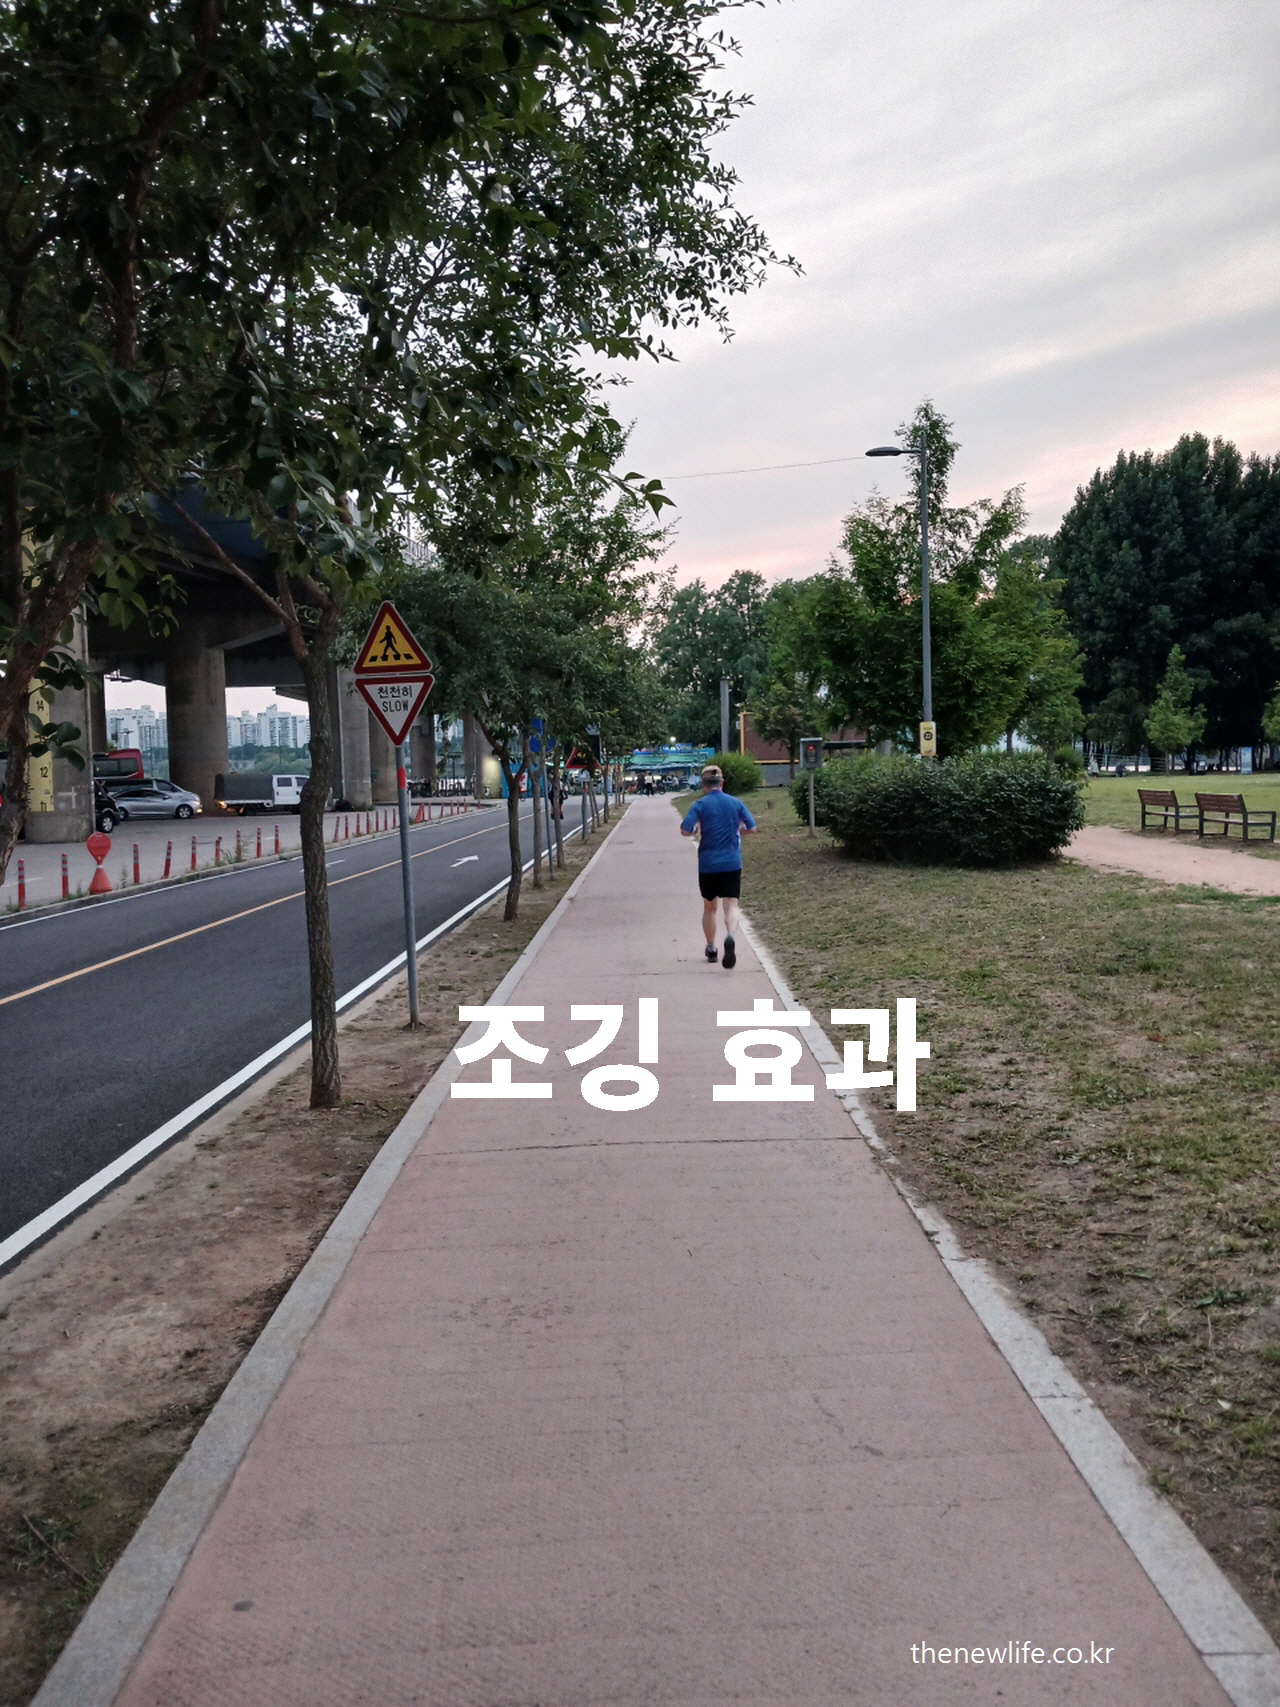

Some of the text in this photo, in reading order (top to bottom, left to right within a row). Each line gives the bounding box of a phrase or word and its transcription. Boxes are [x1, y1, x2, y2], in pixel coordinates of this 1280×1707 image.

[377, 685, 413, 699] 천천히
[36, 700, 45, 711] 14
[382, 700, 409, 713] SLOW
[40, 766, 49, 778] 12
